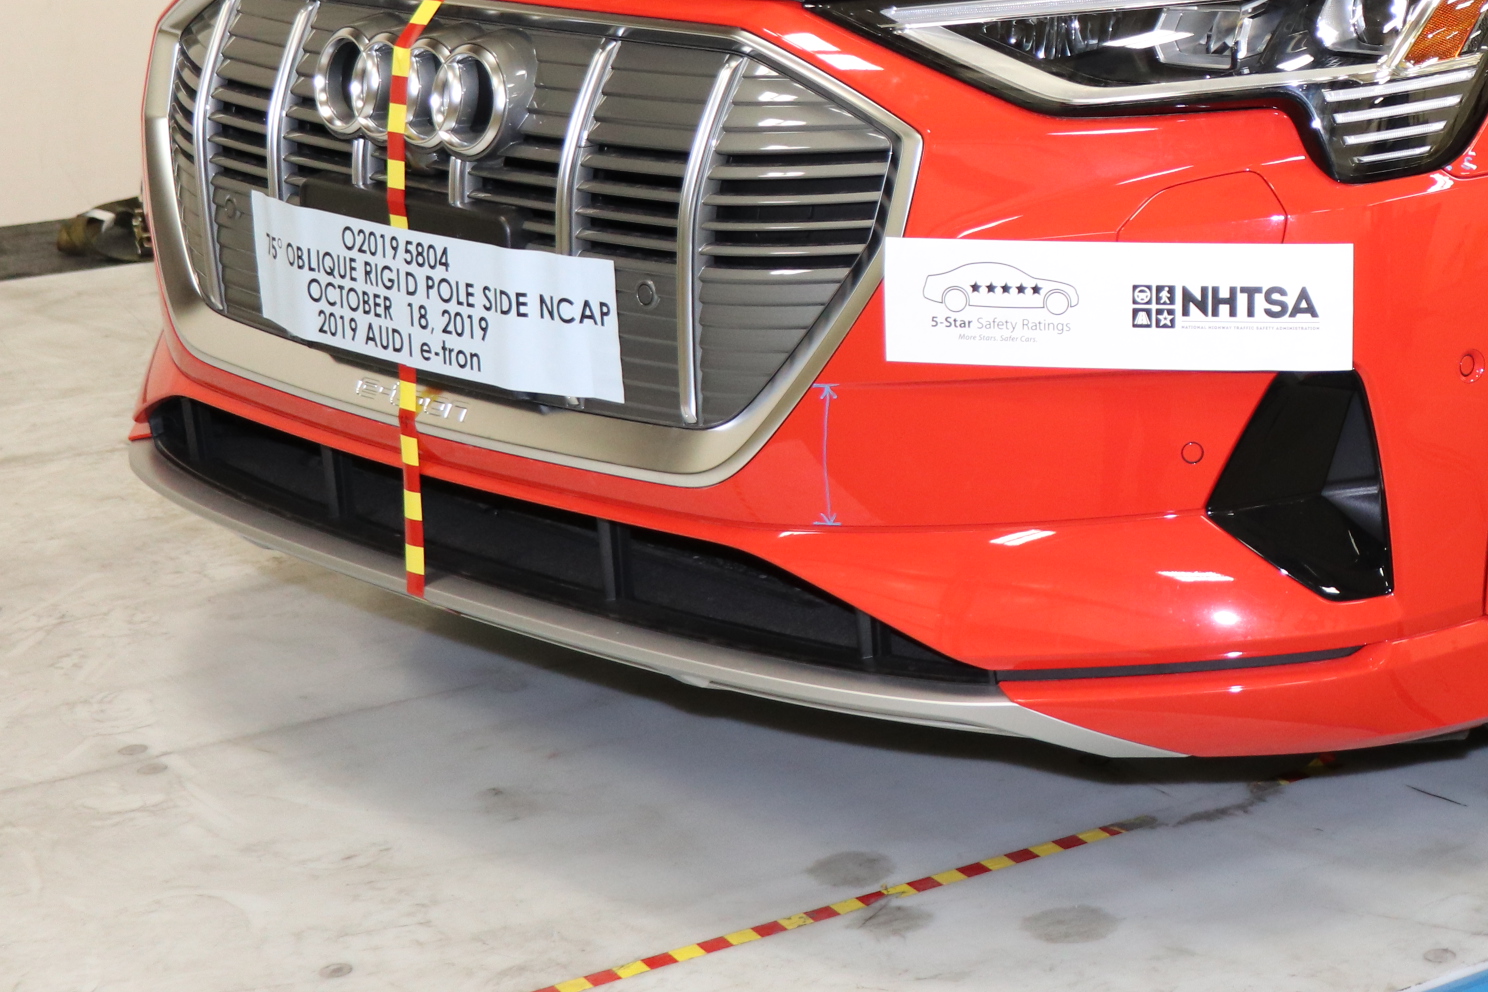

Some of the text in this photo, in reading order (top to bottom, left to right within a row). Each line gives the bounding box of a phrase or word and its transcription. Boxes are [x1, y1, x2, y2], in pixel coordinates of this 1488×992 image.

[286, 243, 358, 283] OBLIQUE
[364, 263, 418, 296] RIGID
[426, 276, 475, 308] POLE
[483, 286, 528, 318] SIDE
[540, 293, 611, 326] NCAP
[308, 279, 489, 341] OCTOBER 18, 2019
[1181, 285, 1319, 318] NHTSA
[318, 309, 482, 372] 2019 AUDI e-tron
[931, 316, 1071, 335] 5-Star Safety Ratings
